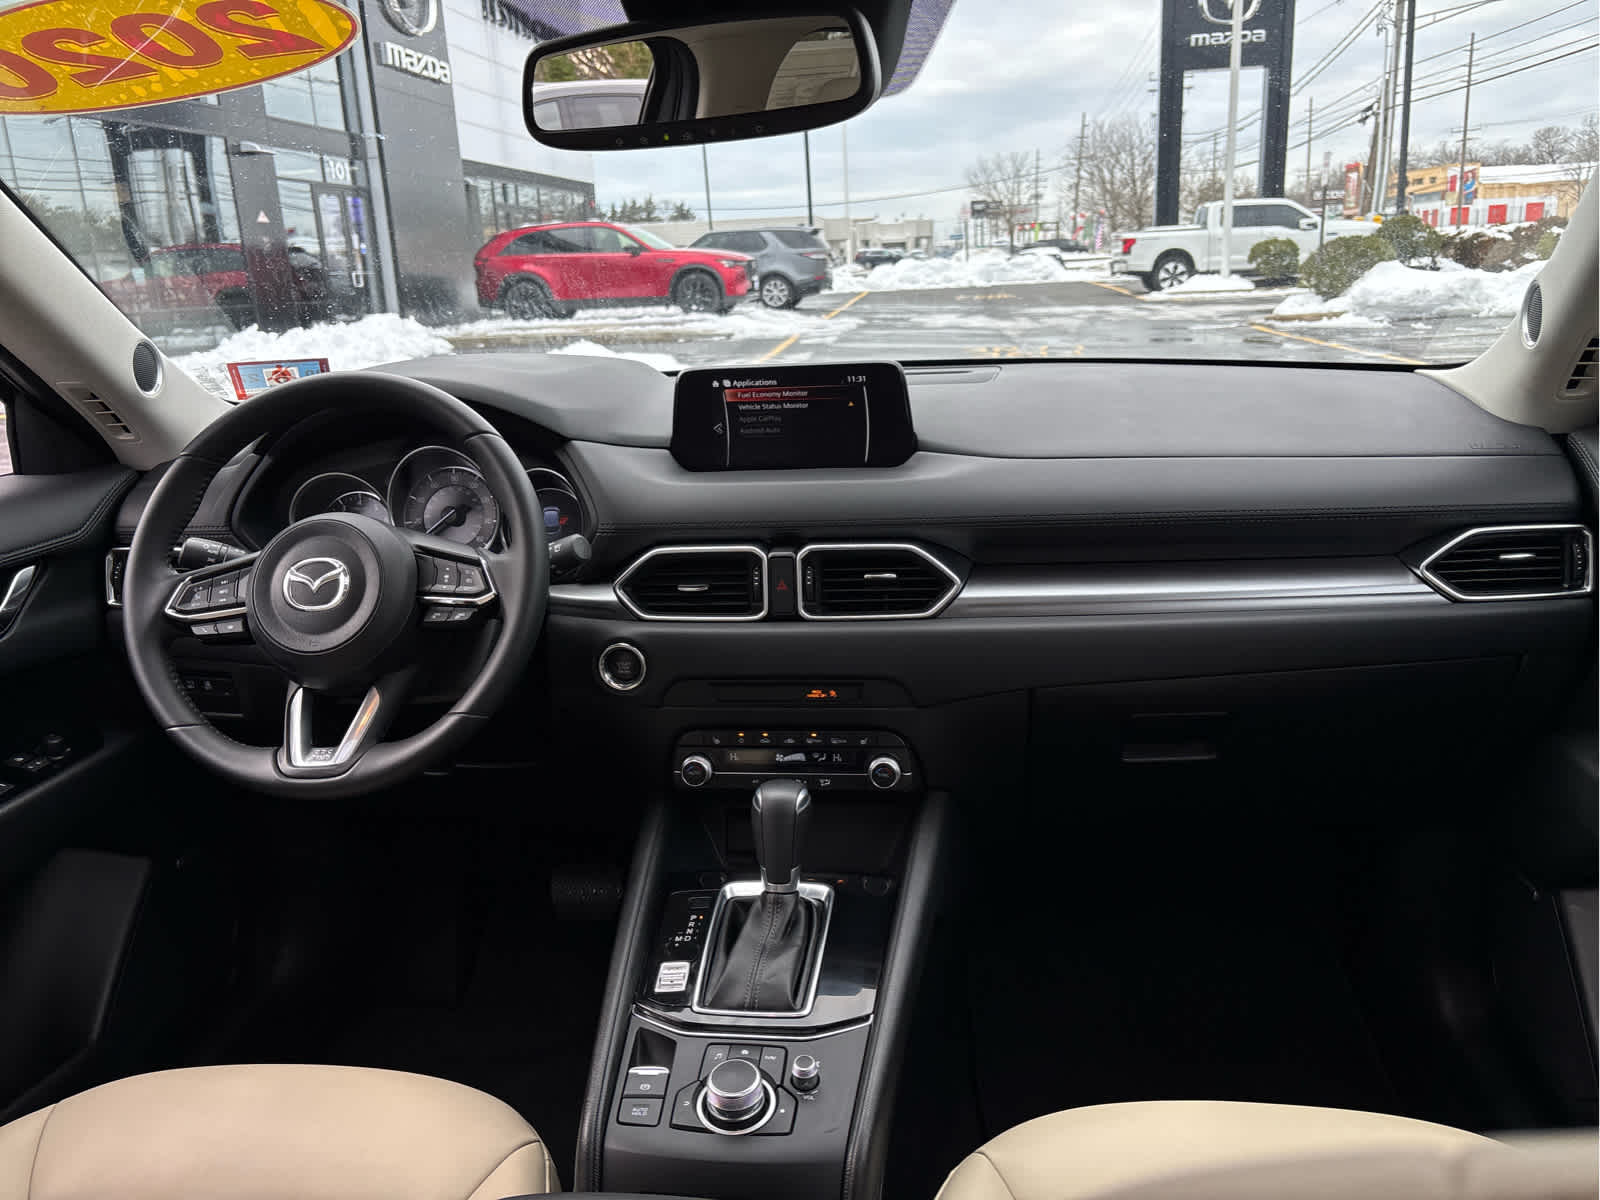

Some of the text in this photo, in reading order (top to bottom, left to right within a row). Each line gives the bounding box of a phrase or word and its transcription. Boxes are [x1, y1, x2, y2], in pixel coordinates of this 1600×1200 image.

[1189, 28, 1267, 48] mazda
[383, 41, 452, 85] mazda
[732, 375, 866, 388] Applications 11:31
[752, 391, 781, 399] Economy
